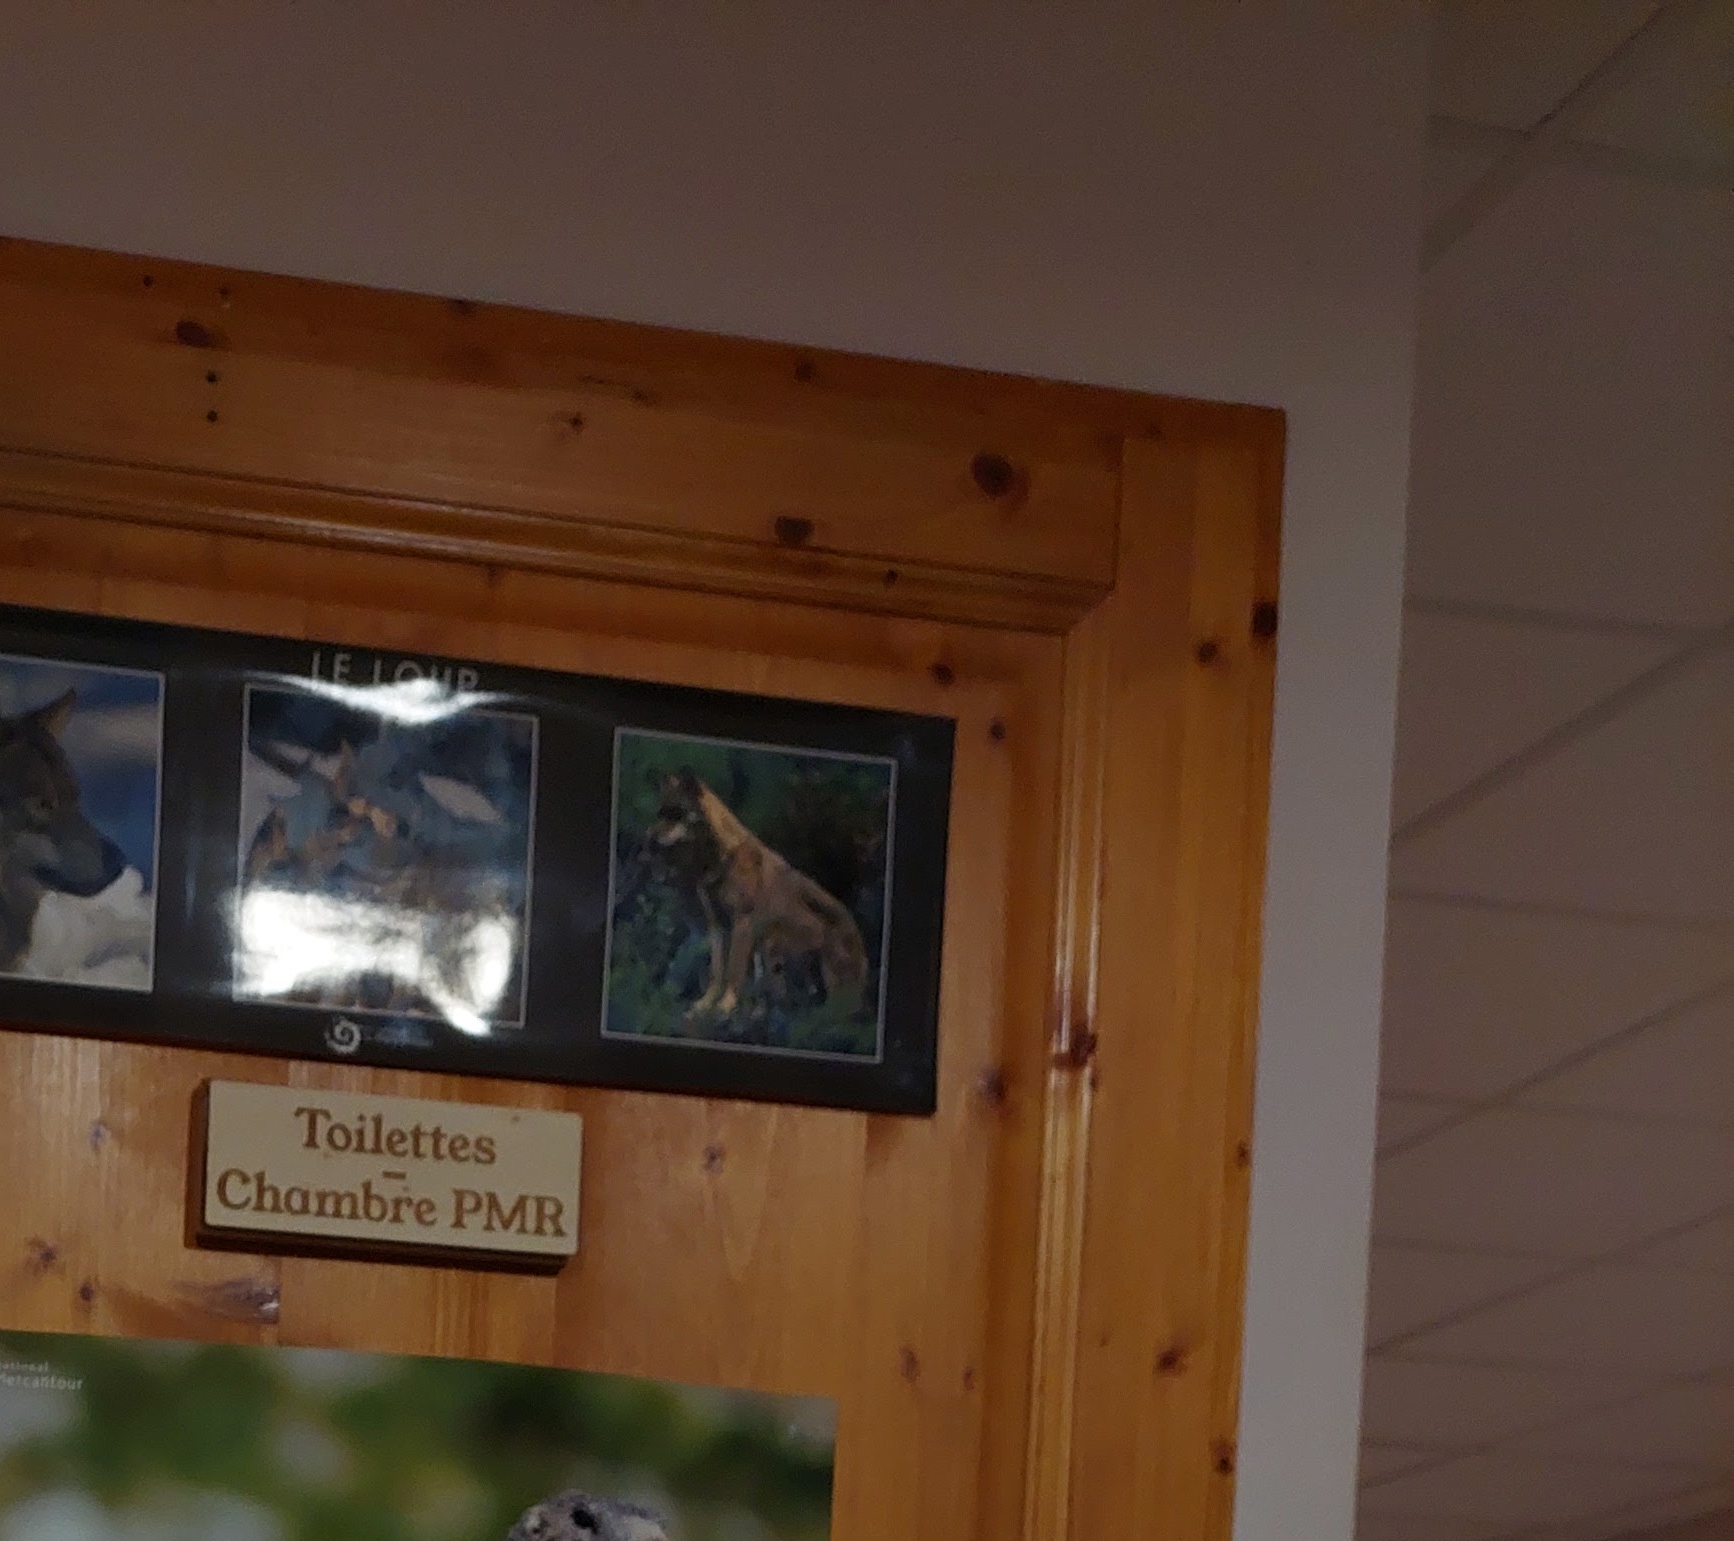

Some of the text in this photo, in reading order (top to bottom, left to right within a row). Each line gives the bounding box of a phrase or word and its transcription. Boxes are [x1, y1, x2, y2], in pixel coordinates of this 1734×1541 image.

[294, 1106, 497, 1164] Toilettes
[216, 1167, 567, 1237] Chambre PMR
